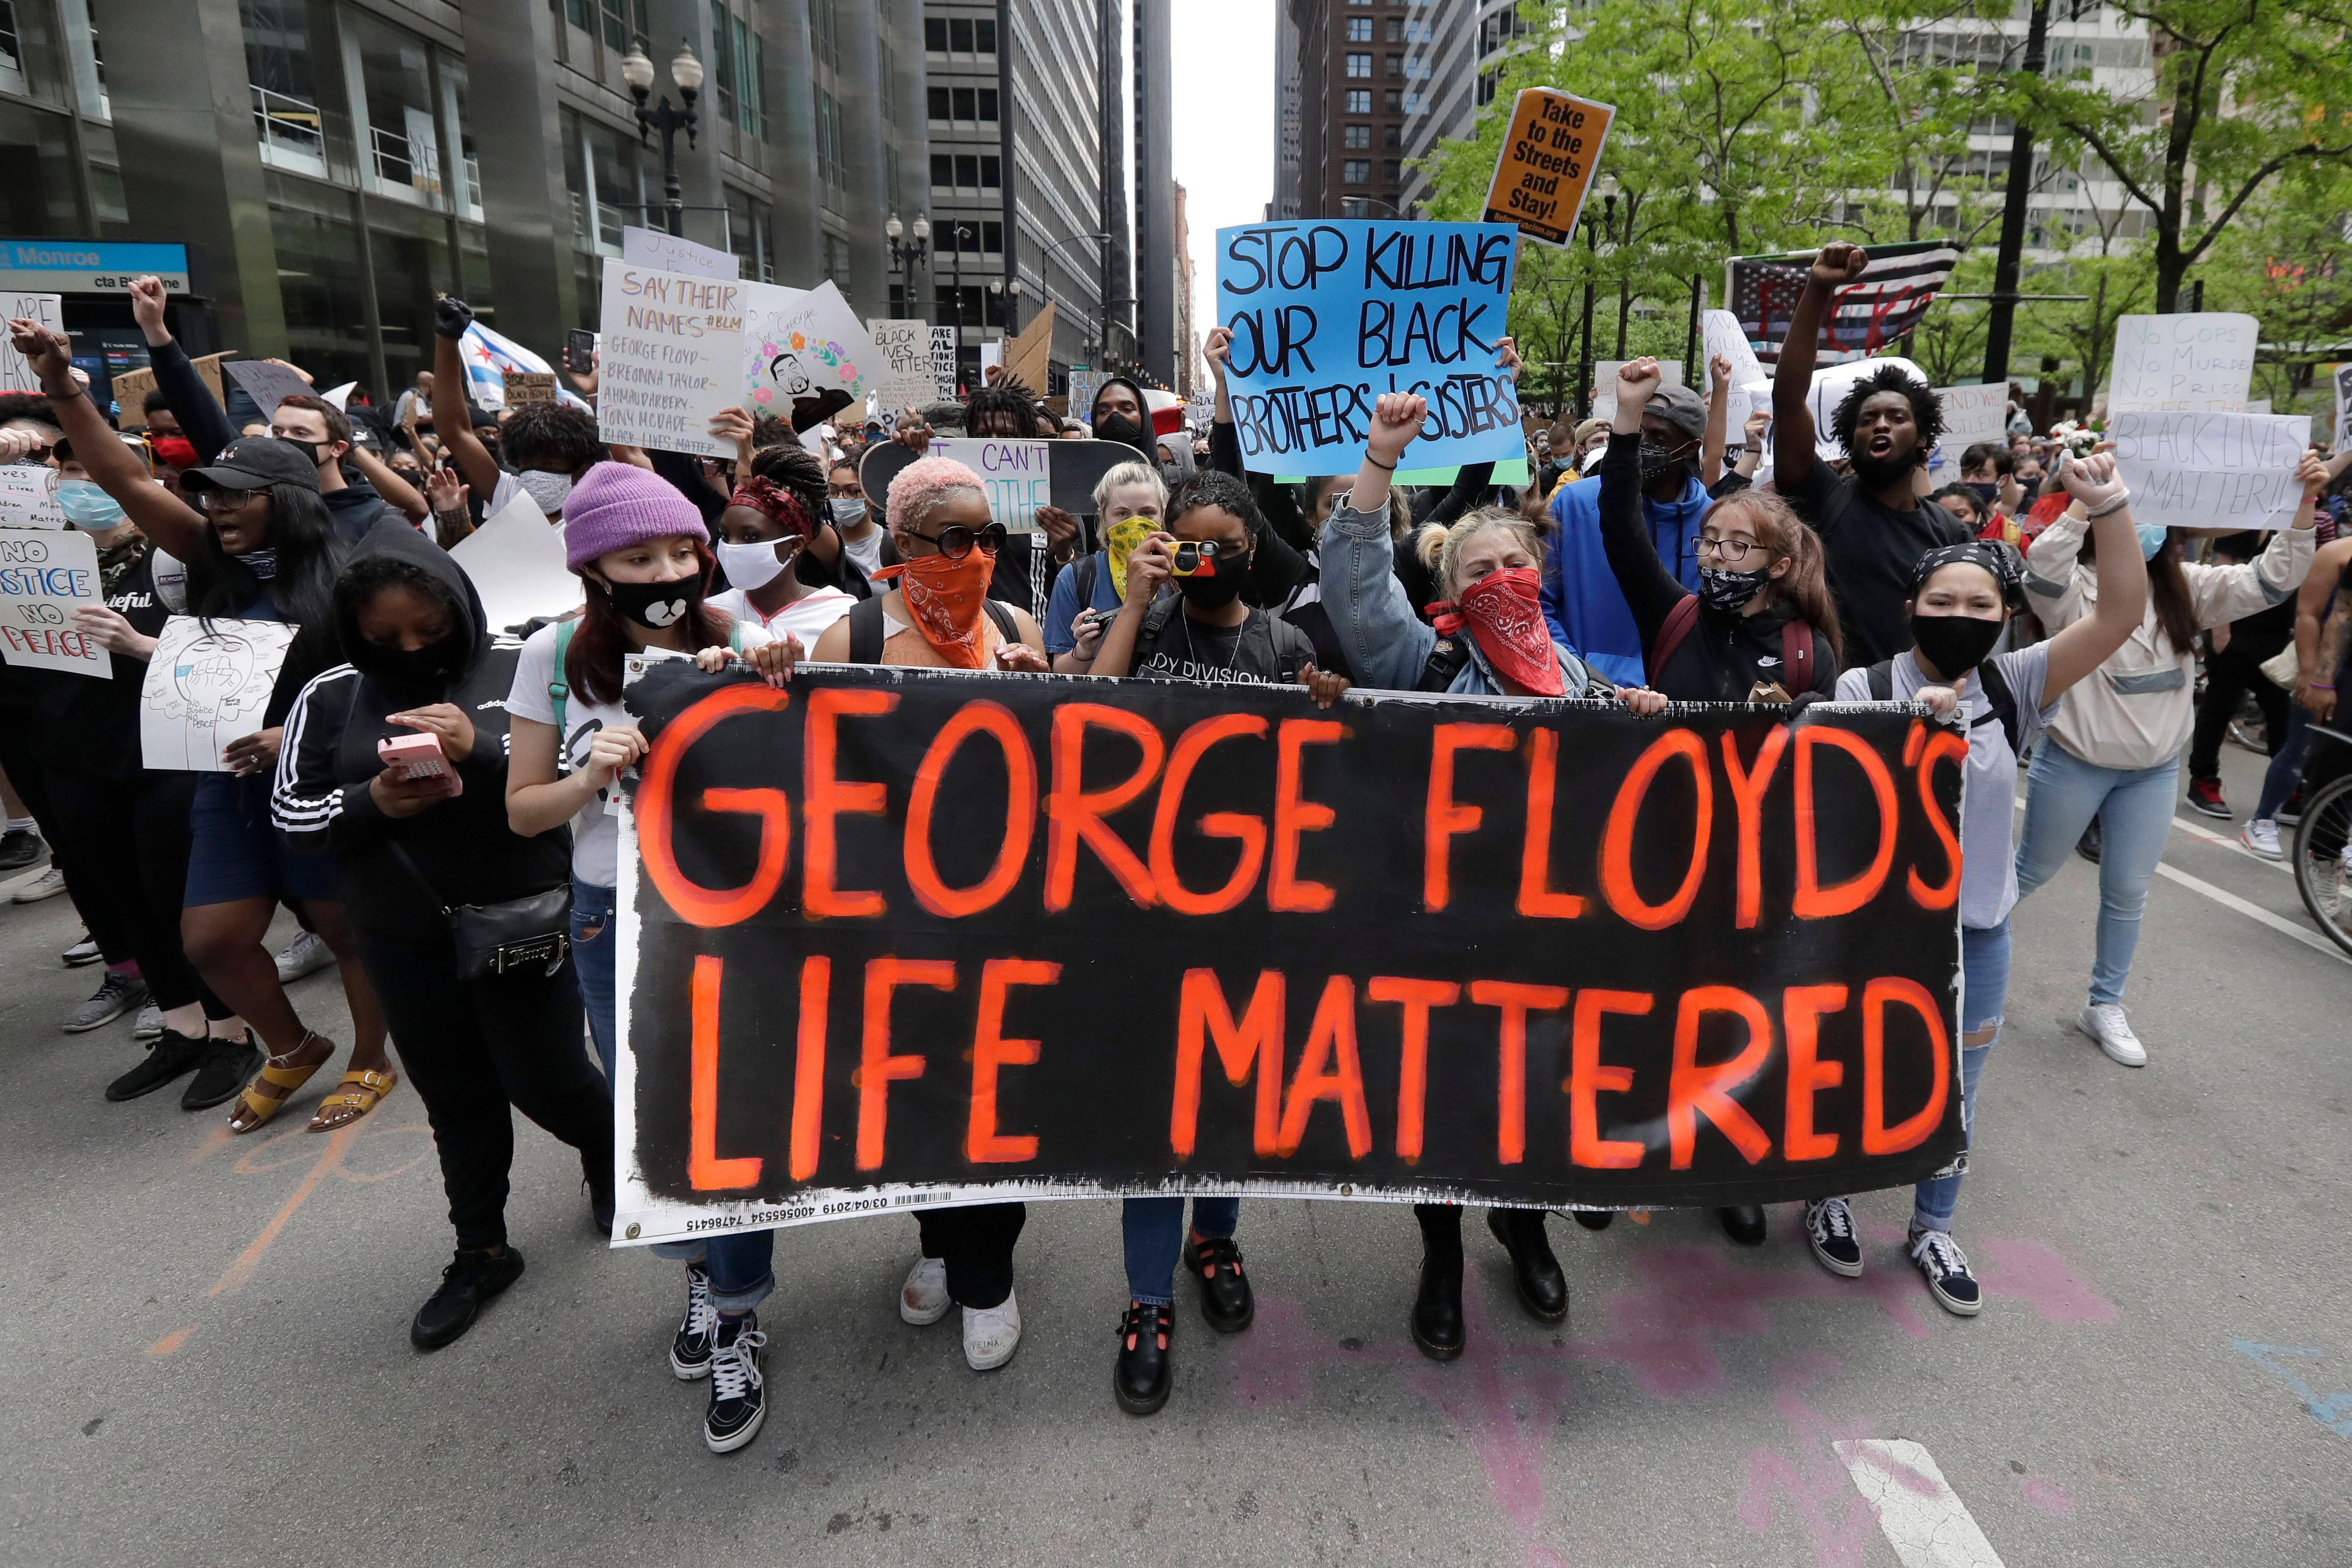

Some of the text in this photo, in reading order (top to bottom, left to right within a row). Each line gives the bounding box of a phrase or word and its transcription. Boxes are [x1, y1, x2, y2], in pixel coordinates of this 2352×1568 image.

[1540, 96, 1585, 130] Take
[1527, 119, 1583, 155] to the
[1513, 140, 1581, 179] Streets
[1521, 172, 1559, 196] and
[1508, 187, 1558, 221] Stay!
[16, 247, 100, 266] Monroe
[645, 234, 714, 268] Justice
[1222, 226, 1512, 295] STOP KILLING
[94, 277, 115, 288] cta
[163, 278, 180, 289] ine
[620, 271, 738, 312] SAY THEIR
[626, 305, 705, 338] NAMES
[705, 314, 742, 330] #BLM
[777, 308, 819, 333] George
[1758, 280, 1914, 357] FCK
[875, 329, 916, 346] BLACK
[928, 340, 953, 350] AL
[931, 327, 951, 339] ARE
[1225, 297, 1495, 378] OUR BLACK
[612, 336, 699, 366] GEORGE FLOYD
[882, 344, 914, 359] IVES
[931, 352, 954, 361] TIONS
[2172, 346, 2251, 371] MURDE
[607, 361, 710, 391] BREONNA TAYLOR
[890, 355, 934, 374] ATTER
[933, 361, 955, 372] TICE
[938, 386, 952, 395] THE
[1074, 371, 1109, 388] BLACK
[2171, 374, 2240, 397] PRISO
[1074, 387, 1099, 402] LIV
[601, 405, 690, 433] TONY MCDADE
[1231, 373, 1521, 457] BROTHERS SISTERS
[604, 428, 716, 454] BLACK LIVES MATTER
[2115, 413, 2304, 470] BLACK LIVES
[981, 443, 1049, 473] CAN'T
[2, 470, 27, 479] ves
[8, 484, 34, 493] Lives
[2136, 469, 2289, 515] MATTER!!
[0, 500, 62, 510] dren Mat
[29, 513, 68, 524] Matter
[1, 540, 48, 563] NO
[0, 567, 92, 597] STICE
[17, 604, 64, 625] NO
[1, 625, 98, 660] PEACE
[1148, 652, 1267, 684] JOY DIVISION
[1761, 655, 1778, 664] NIKE
[477, 699, 506, 710] adida
[193, 719, 215, 729] PEACE
[635, 682, 1969, 930] GEORGE FLOYD'S
[688, 954, 1951, 1191] LIFE MATTERED
[687, 1197, 887, 1231] 03/04/2019 400565534 74786415
